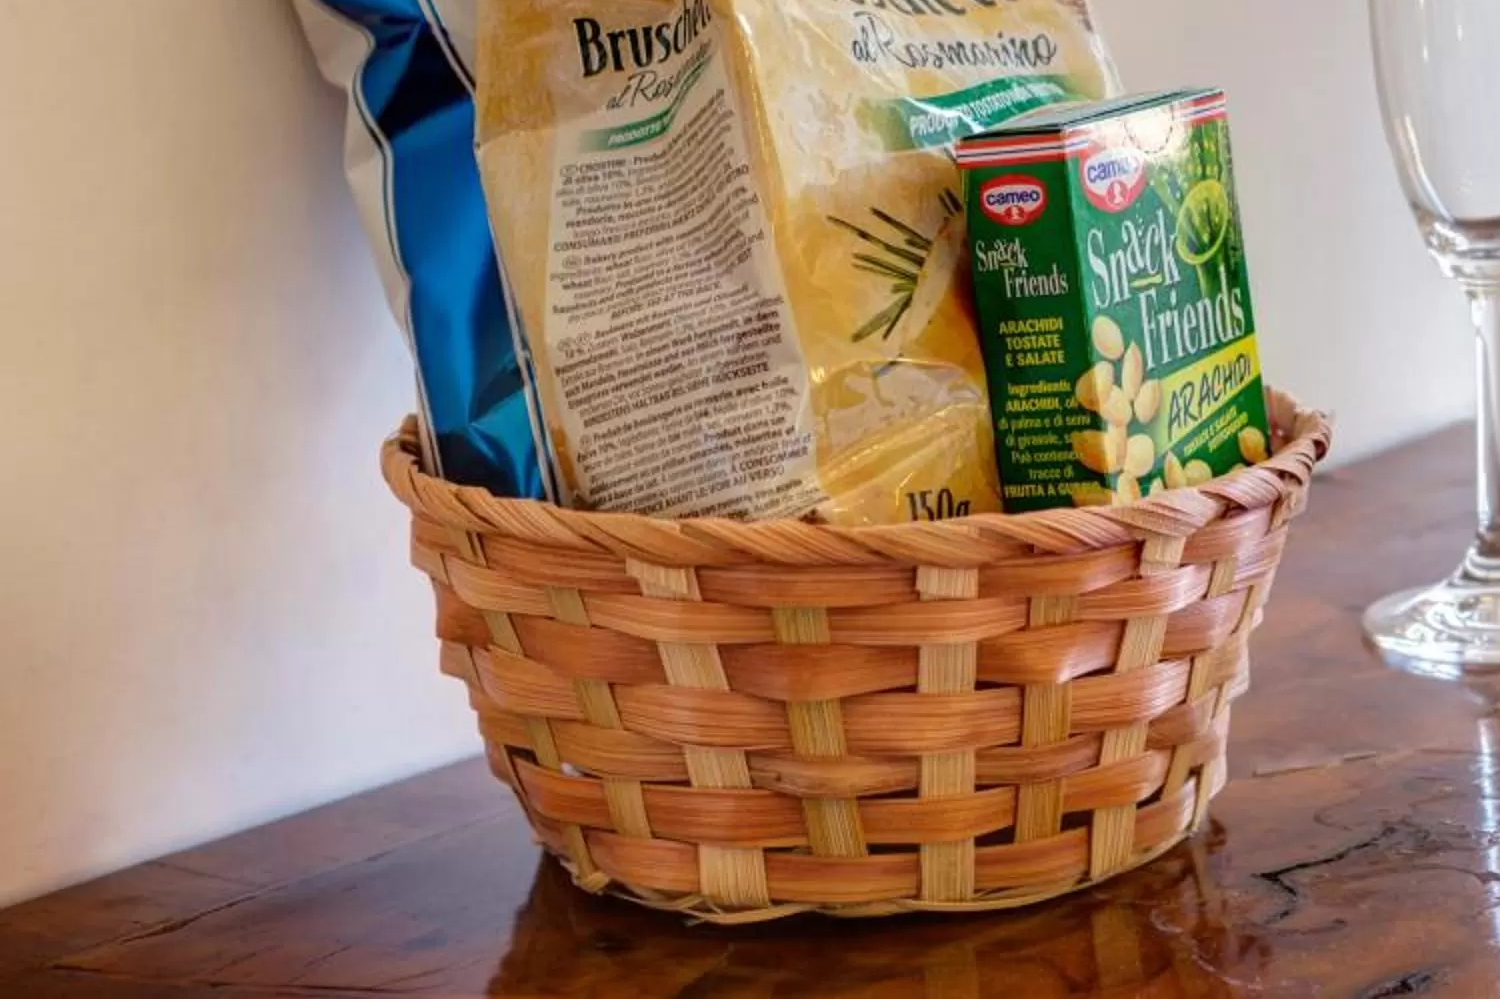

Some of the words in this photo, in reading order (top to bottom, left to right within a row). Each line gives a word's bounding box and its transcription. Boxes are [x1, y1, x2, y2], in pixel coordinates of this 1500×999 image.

[985, 189, 1041, 206] cameo
[975, 237, 1029, 272] Snack
[1087, 208, 1181, 309] Snack
[1003, 263, 1069, 299] Friends
[999, 316, 1064, 335] ARACHIDI
[1139, 264, 1245, 371] Friends
[1005, 354, 1014, 368] E
[1016, 350, 1066, 367] SALATE
[1006, 334, 1062, 351] TOSTATE
[1167, 352, 1251, 442] ARACHIDI
